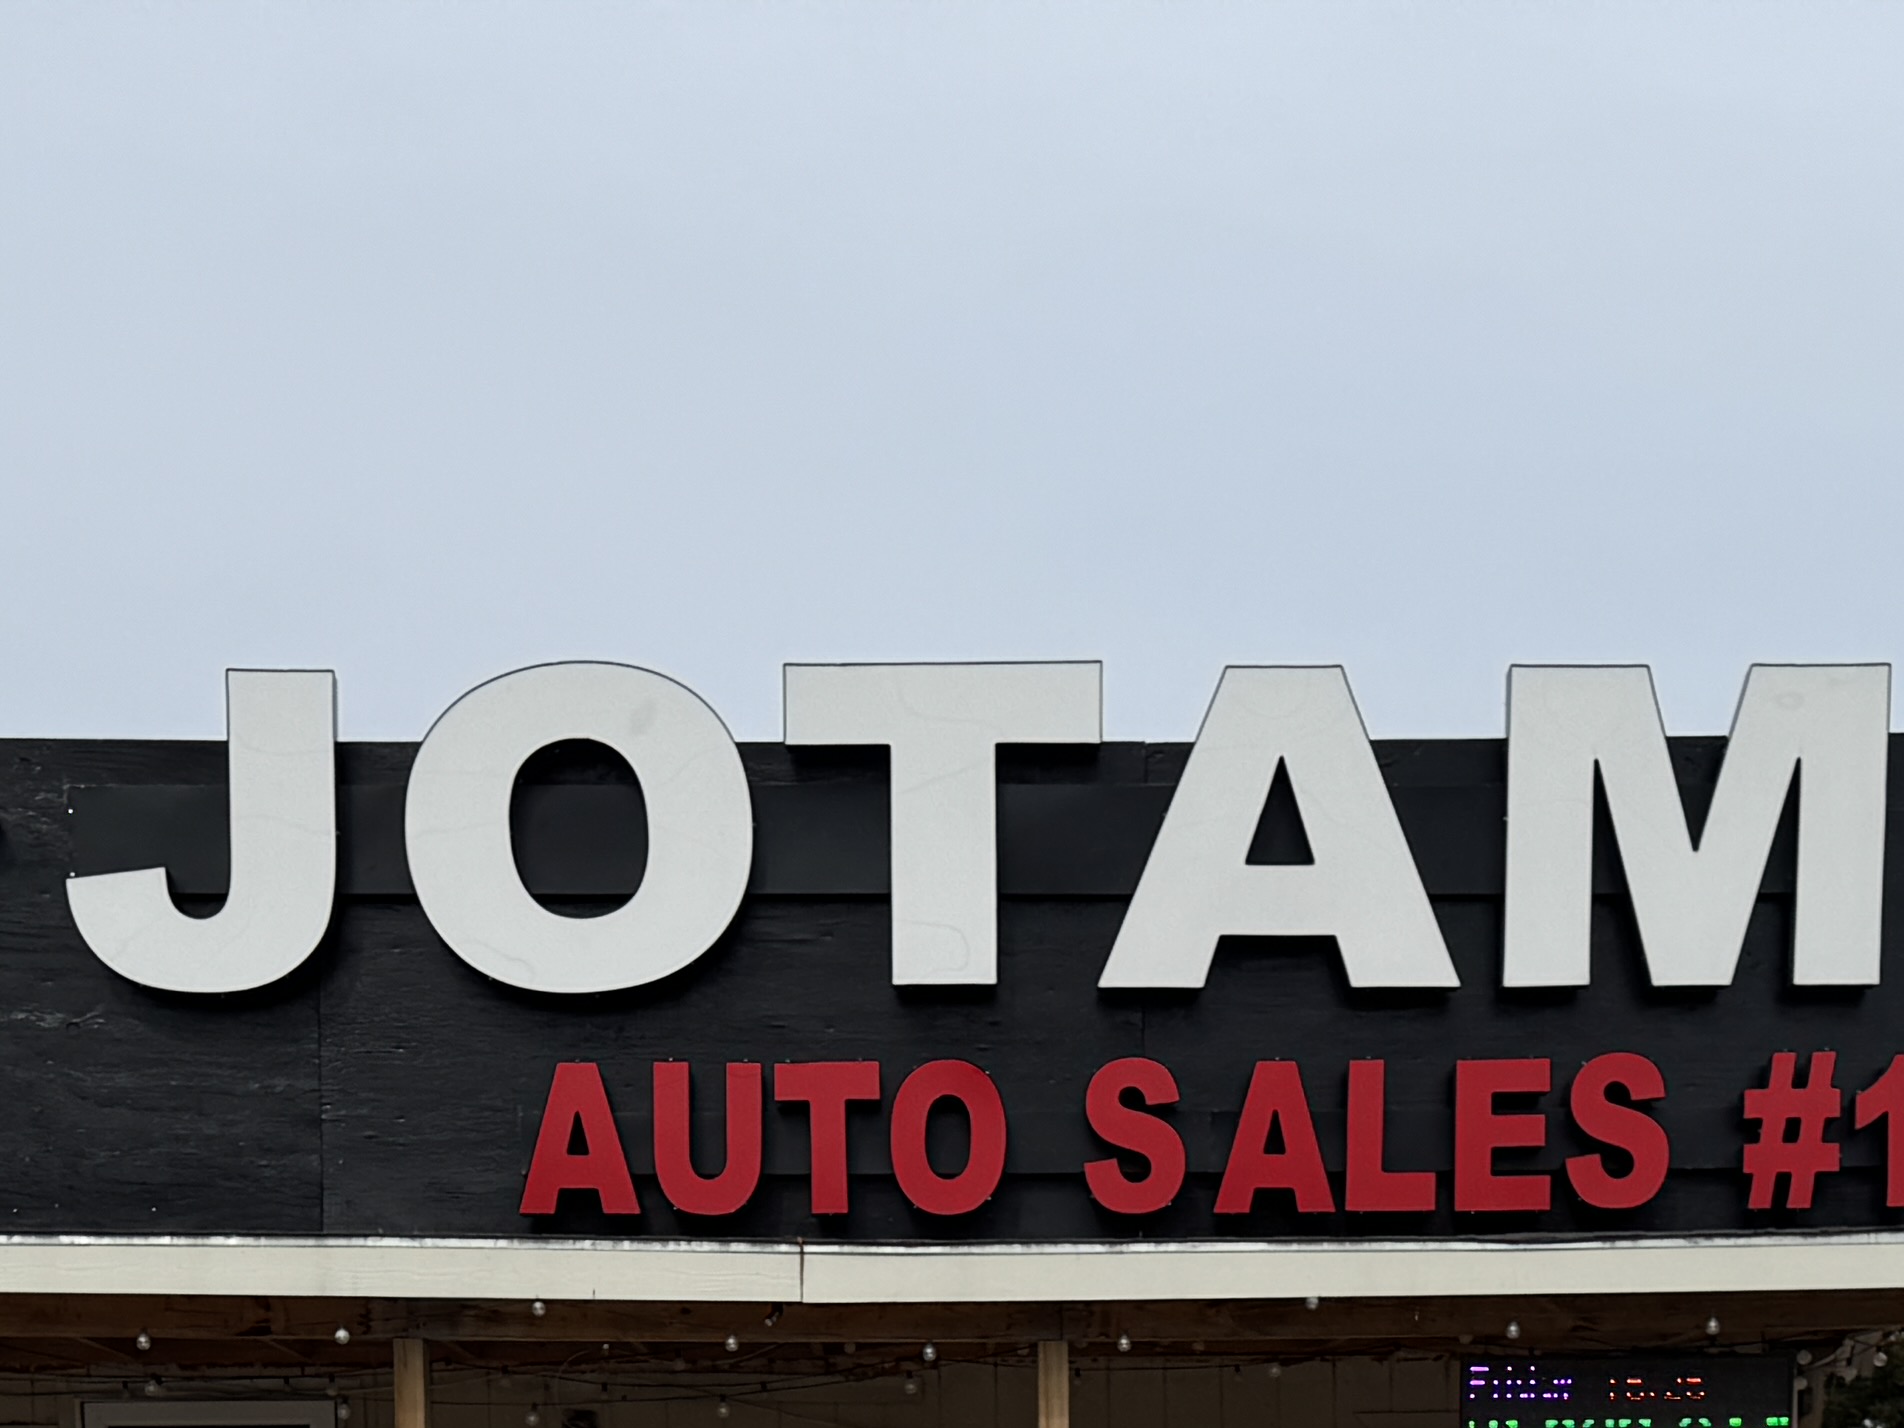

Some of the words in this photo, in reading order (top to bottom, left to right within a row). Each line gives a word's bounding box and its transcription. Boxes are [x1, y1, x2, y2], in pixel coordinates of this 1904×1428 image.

[66, 660, 1892, 994] JOTAM
[519, 1057, 1007, 1216] AUTO
[1084, 1051, 1669, 1213] SALES
